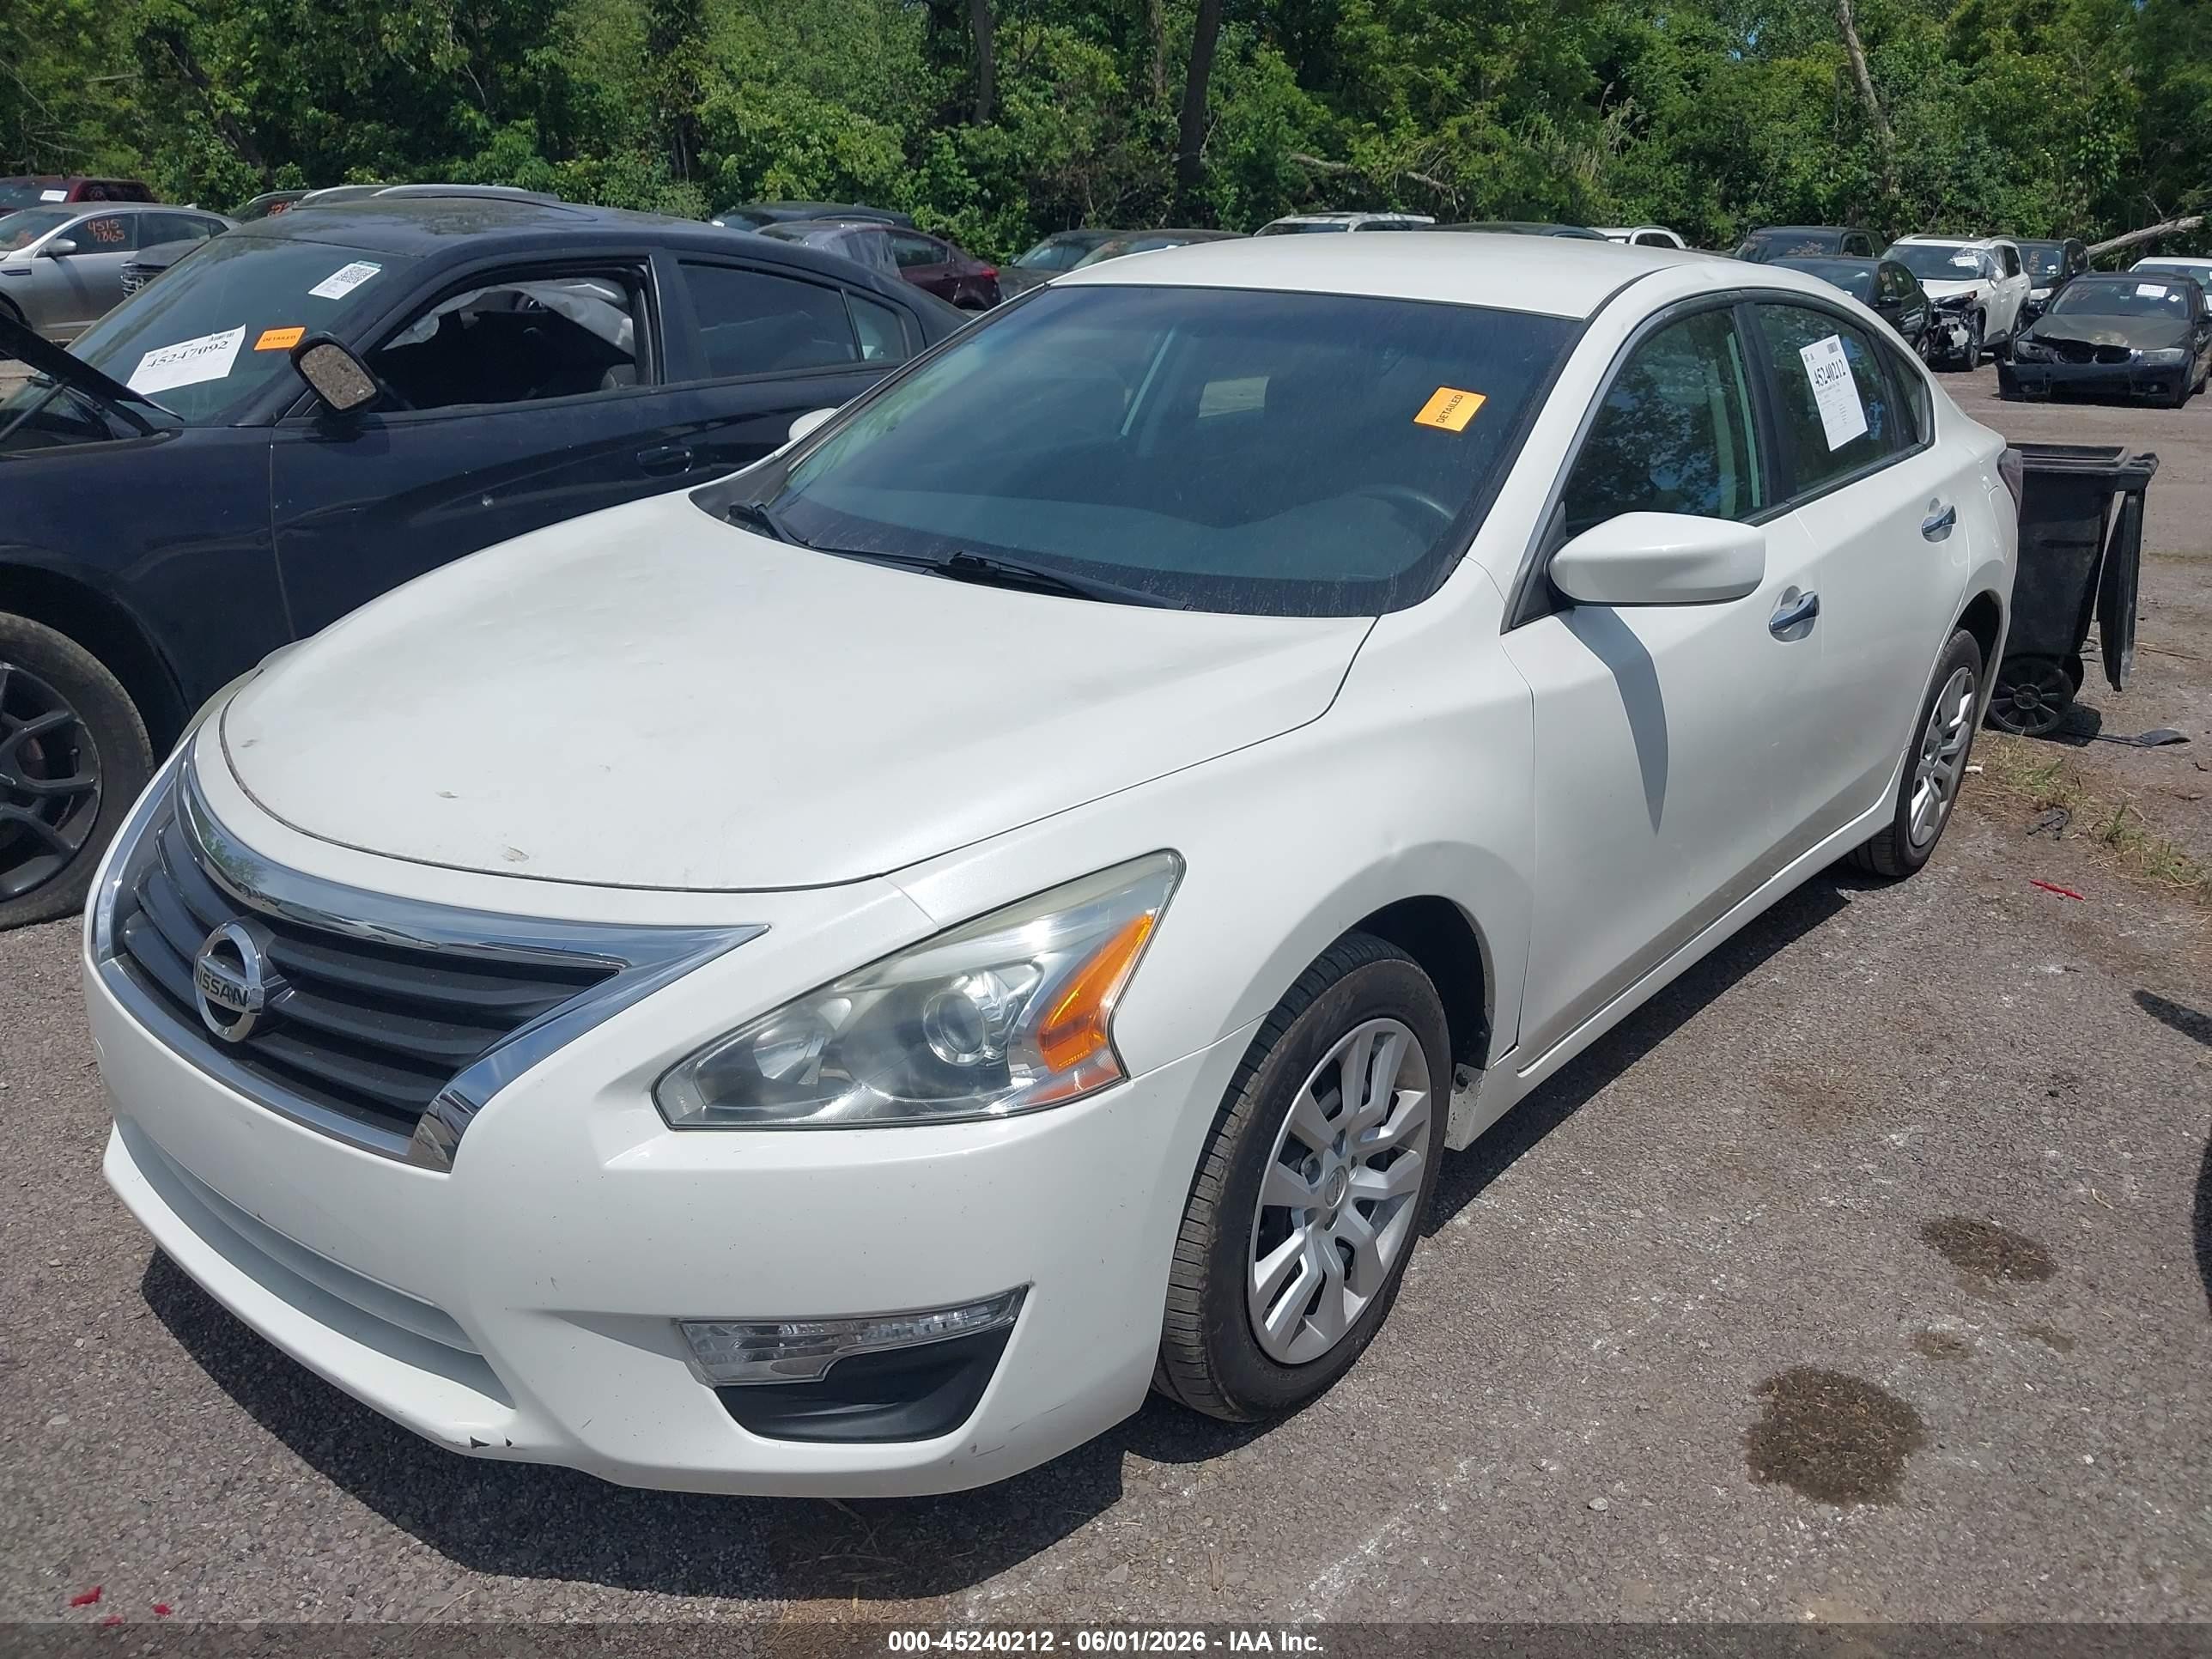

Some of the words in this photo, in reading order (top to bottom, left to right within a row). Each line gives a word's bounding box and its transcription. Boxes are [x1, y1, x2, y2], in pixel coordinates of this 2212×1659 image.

[147, 341, 228, 368] 45247092
[1814, 359, 1846, 387] 45240212
[1436, 394, 1463, 423] DETAILED
[196, 968, 248, 1007] NISSAN
